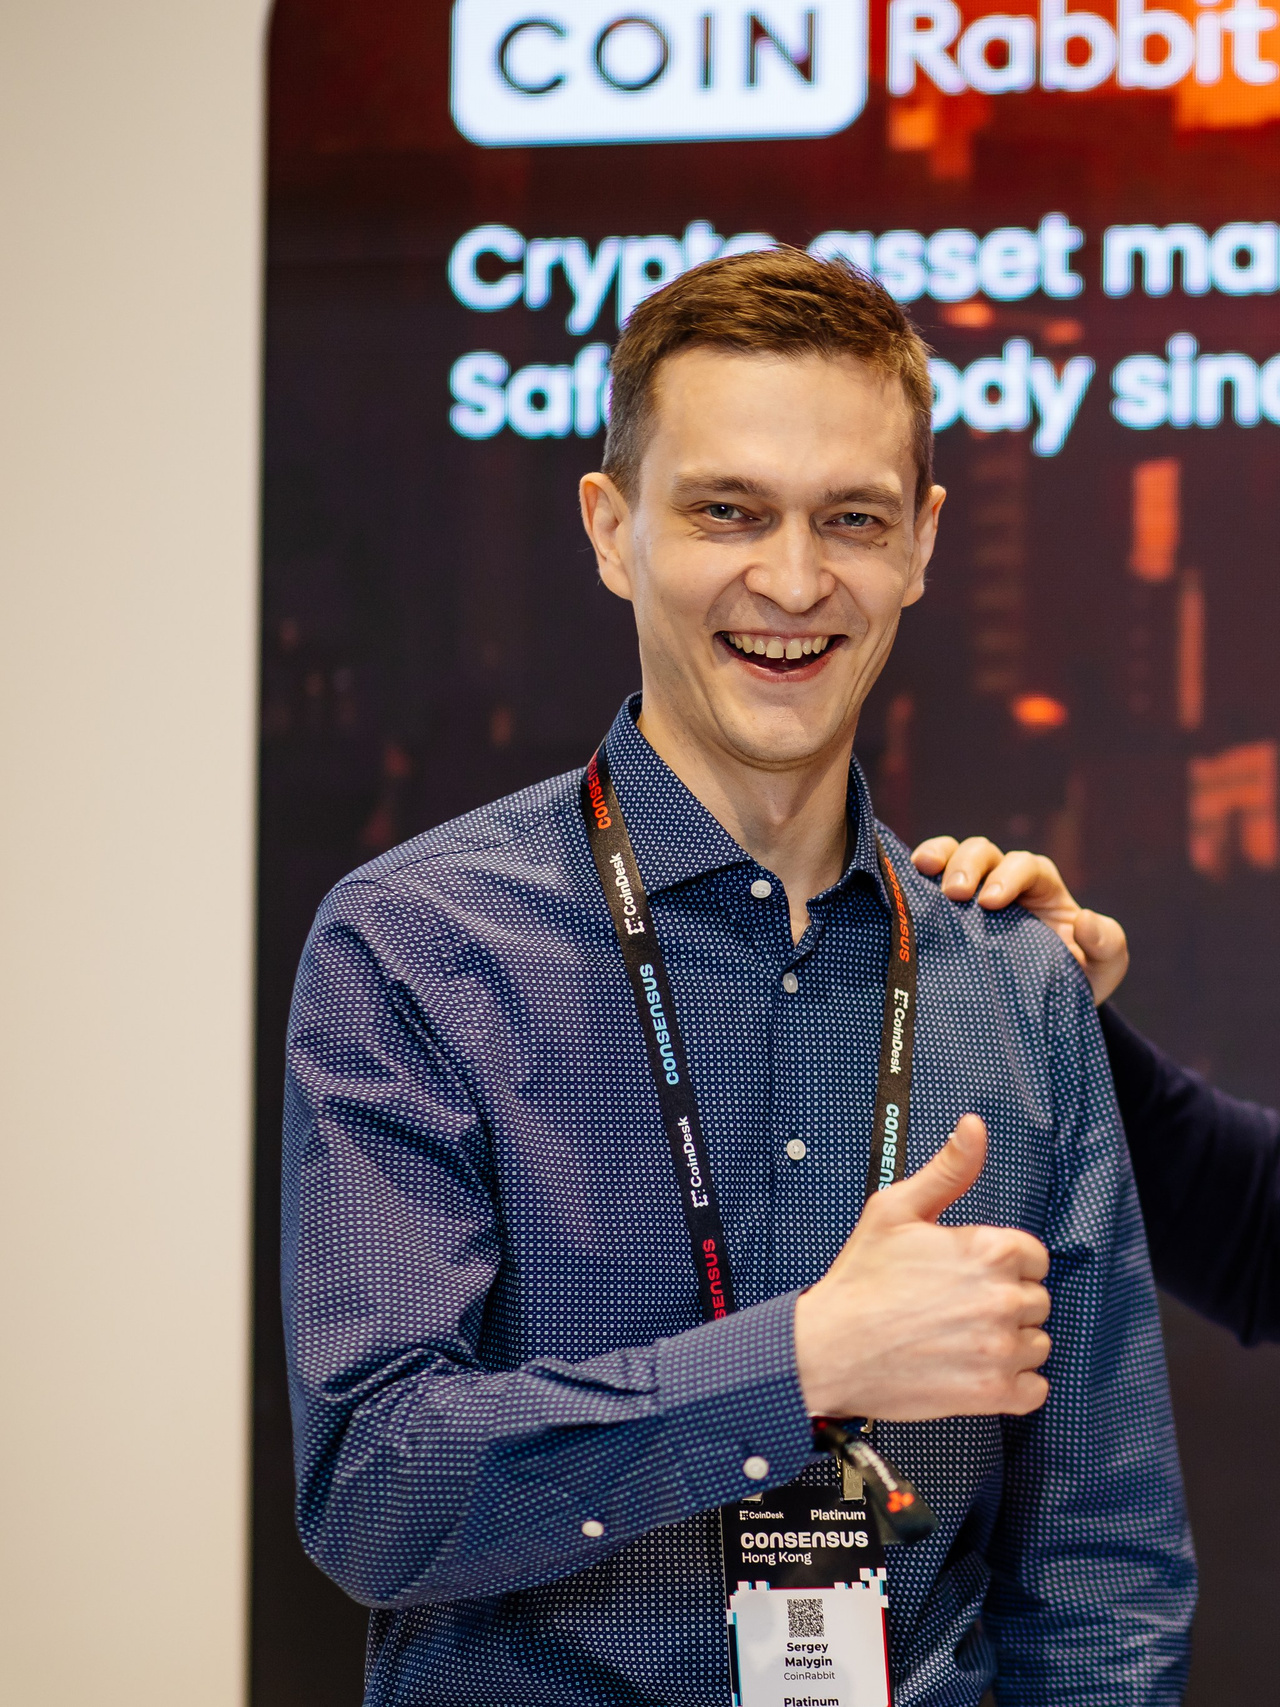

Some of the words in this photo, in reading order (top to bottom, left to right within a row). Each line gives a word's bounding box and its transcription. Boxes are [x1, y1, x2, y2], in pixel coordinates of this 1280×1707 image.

[497, 6, 818, 95] COIN
[887, 0, 1280, 97] Rabbit
[448, 219, 779, 335] Crypt
[448, 342, 613, 440] Saf
[609, 852, 637, 916] CoinDesk
[890, 1007, 906, 1075] CoinDesk
[677, 1115, 702, 1188] CoinDesk
[702, 1238, 727, 1320] SENSUS
[749, 1511, 784, 1520] CoinDesk
[810, 1509, 866, 1521] Platinum
[742, 1552, 777, 1566] Hong
[778, 1551, 812, 1565] Kong
[785, 1655, 833, 1669] Malygin
[786, 1642, 829, 1654] Sergey
[783, 1671, 836, 1681] CoinRabbit
[784, 1696, 839, 1707] Platinum
